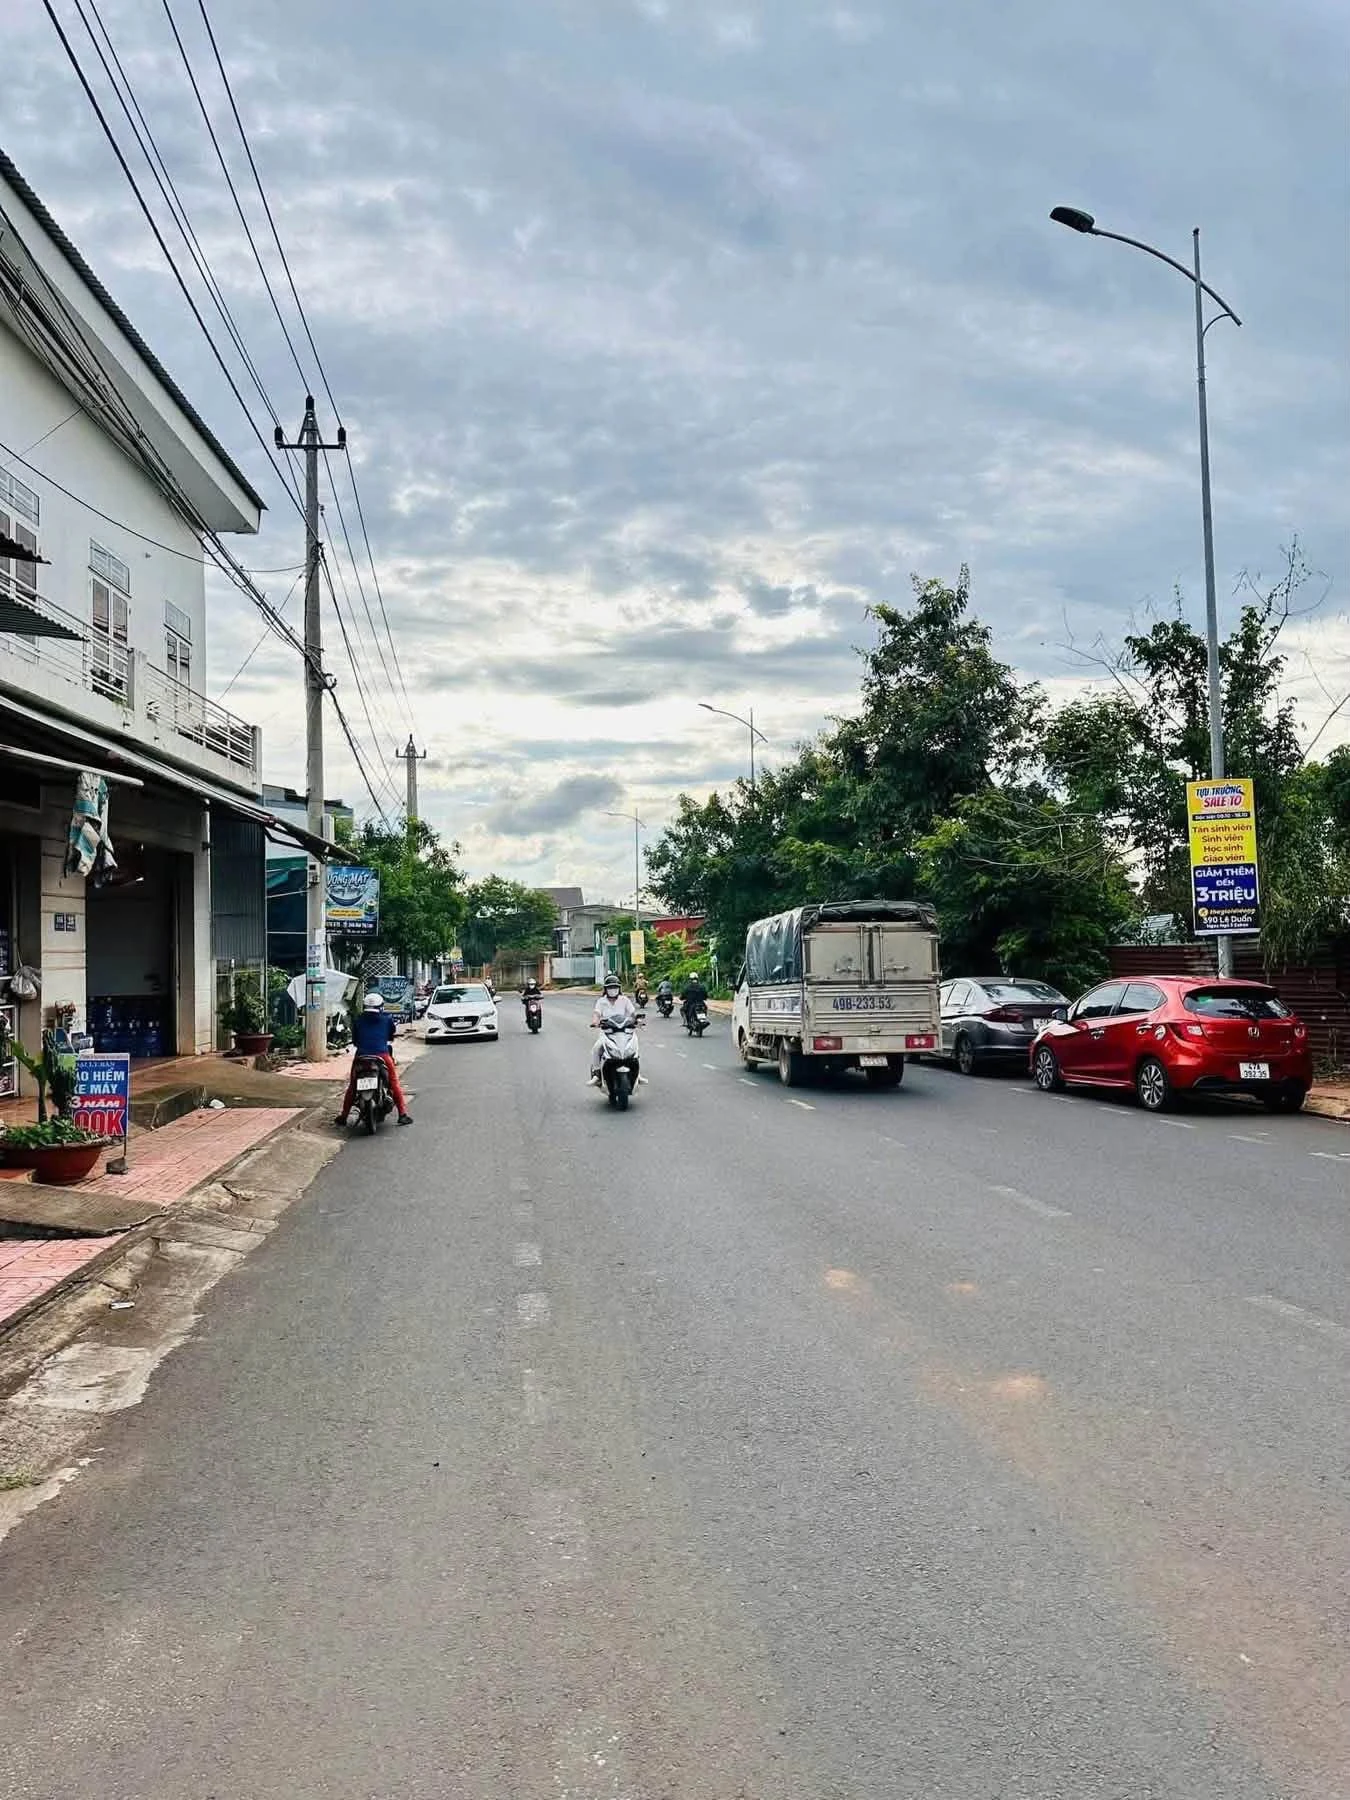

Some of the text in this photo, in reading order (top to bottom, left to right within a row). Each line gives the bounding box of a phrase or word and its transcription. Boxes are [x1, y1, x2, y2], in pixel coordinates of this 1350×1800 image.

[1203, 796, 1227, 808] SALE
[1202, 835, 1222, 843] Sinh
[1223, 843, 1243, 852] sinh
[1224, 865, 1254, 877] THÊM
[93, 1067, 125, 1081] HIỂM
